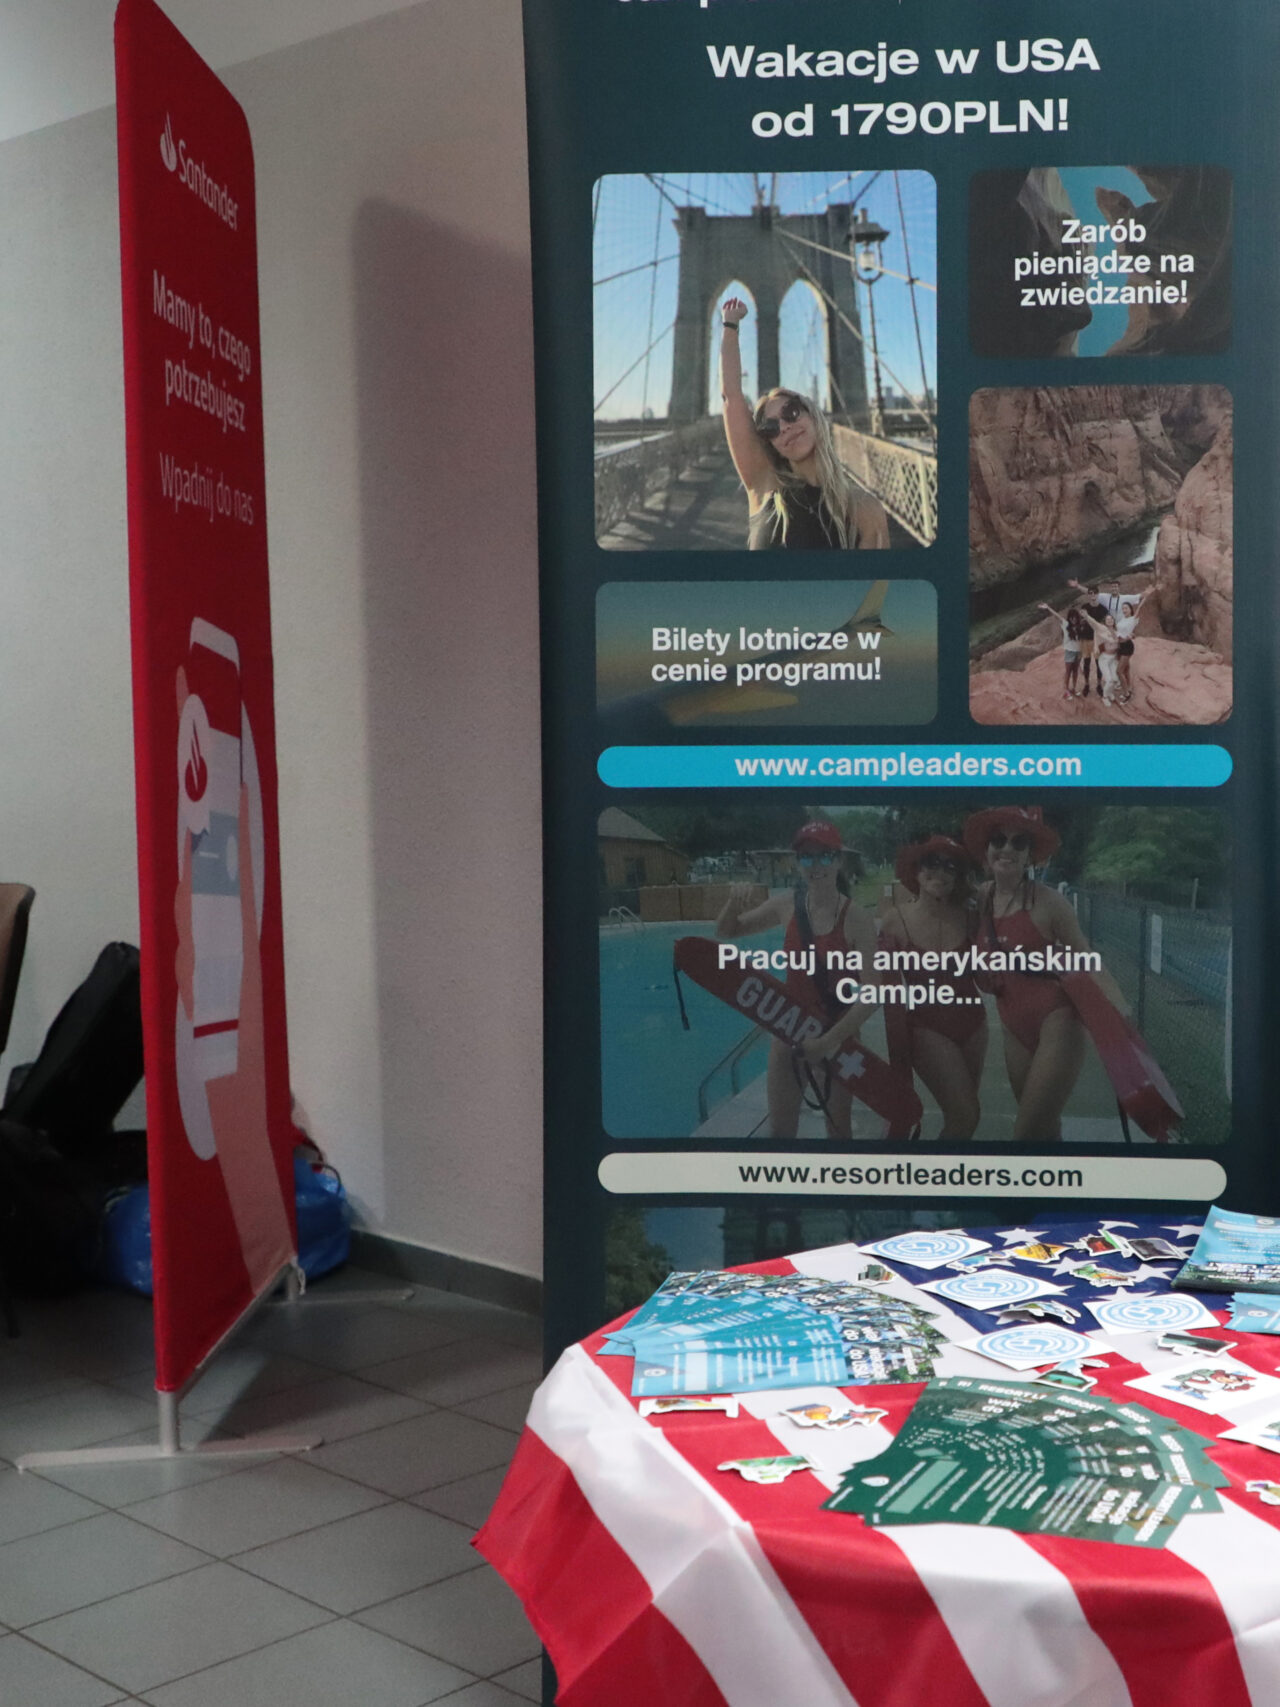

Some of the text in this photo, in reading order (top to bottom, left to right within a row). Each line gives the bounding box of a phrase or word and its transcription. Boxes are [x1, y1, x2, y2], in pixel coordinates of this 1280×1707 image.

[706, 38, 1101, 84] Wakacje w USA
[751, 98, 1069, 138] od 1790PLN!
[178, 139, 238, 231] Santander
[1061, 218, 1147, 244] Zarób
[1014, 249, 1195, 281] pieniądze na
[1020, 280, 1189, 307] zwiedzanie!
[153, 269, 251, 382] Mamy to, czego
[165, 359, 246, 433] potrzebujesz
[160, 452, 254, 526] Wpadnij do nas
[651, 626, 883, 657] Bilety lotnicze w
[650, 657, 882, 688] cenie programu!
[734, 751, 1083, 781] www.campleaders.com
[717, 943, 1102, 977] Pracuj na amerykańskim
[834, 977, 982, 1010] Campie...
[738, 1161, 1085, 1190] www.resortleaders.com
